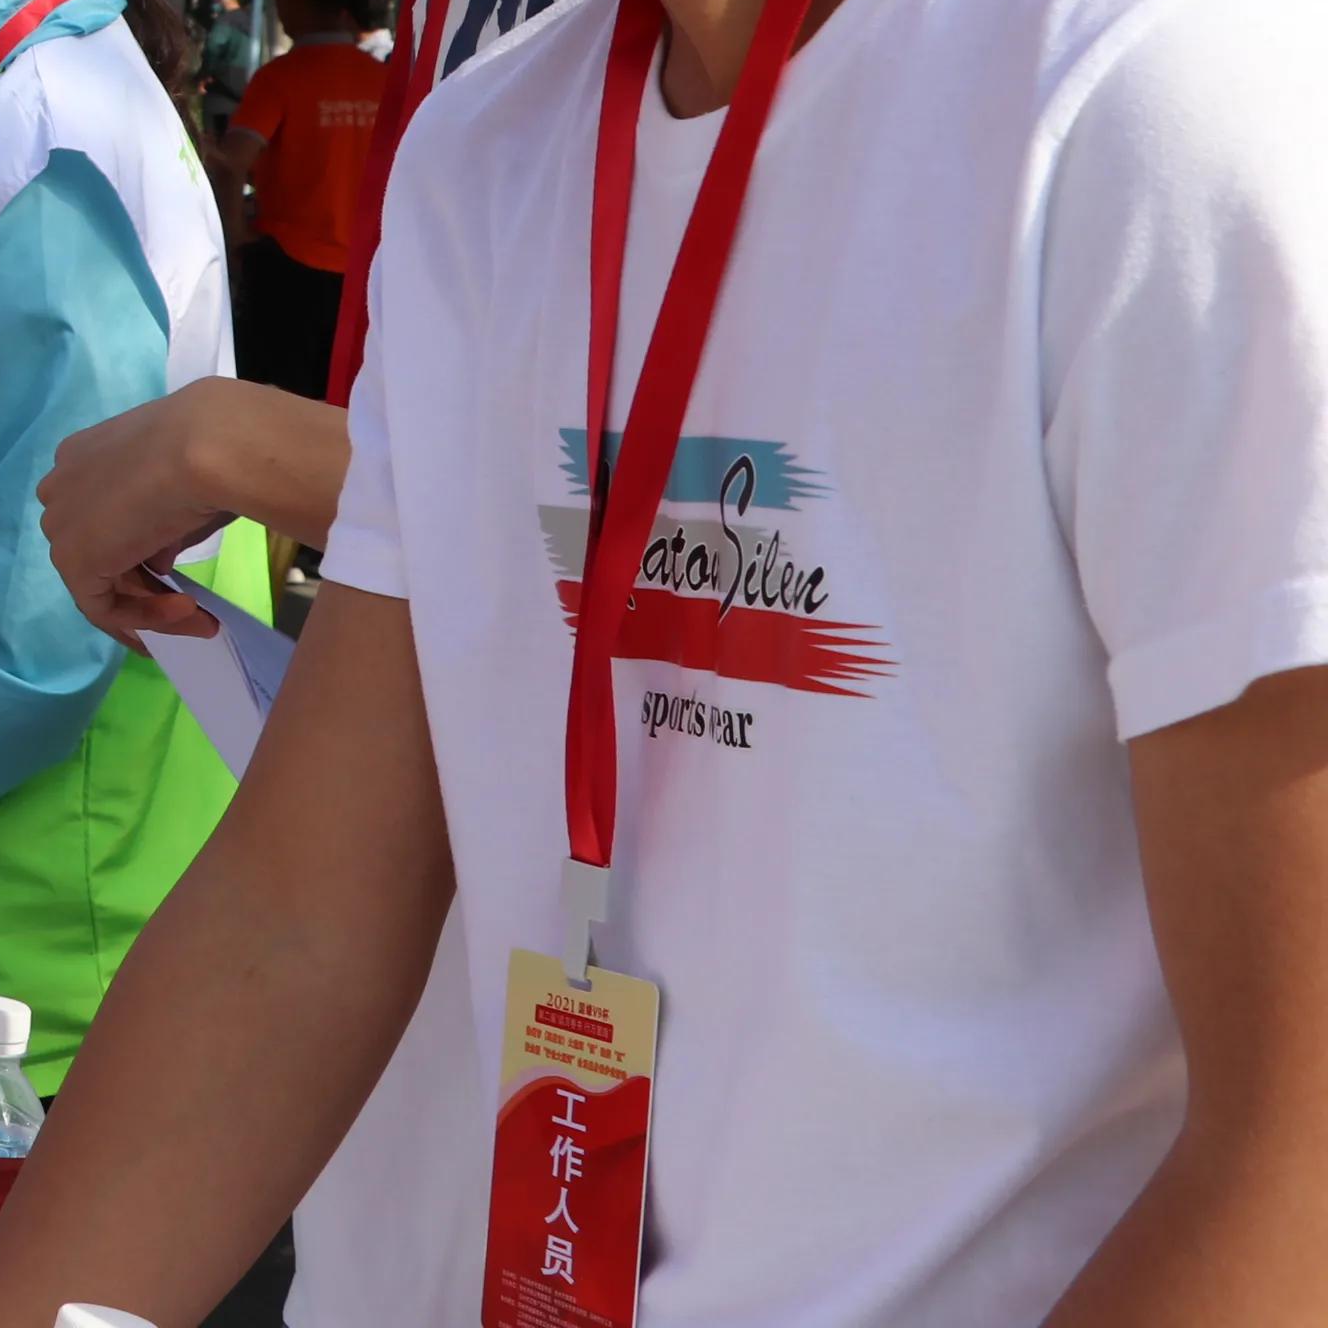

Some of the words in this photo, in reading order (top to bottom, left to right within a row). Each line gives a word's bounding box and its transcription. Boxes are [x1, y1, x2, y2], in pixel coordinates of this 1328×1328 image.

[546, 992, 576, 1013] 2021
[540, 1087, 587, 1284] 工作人员
